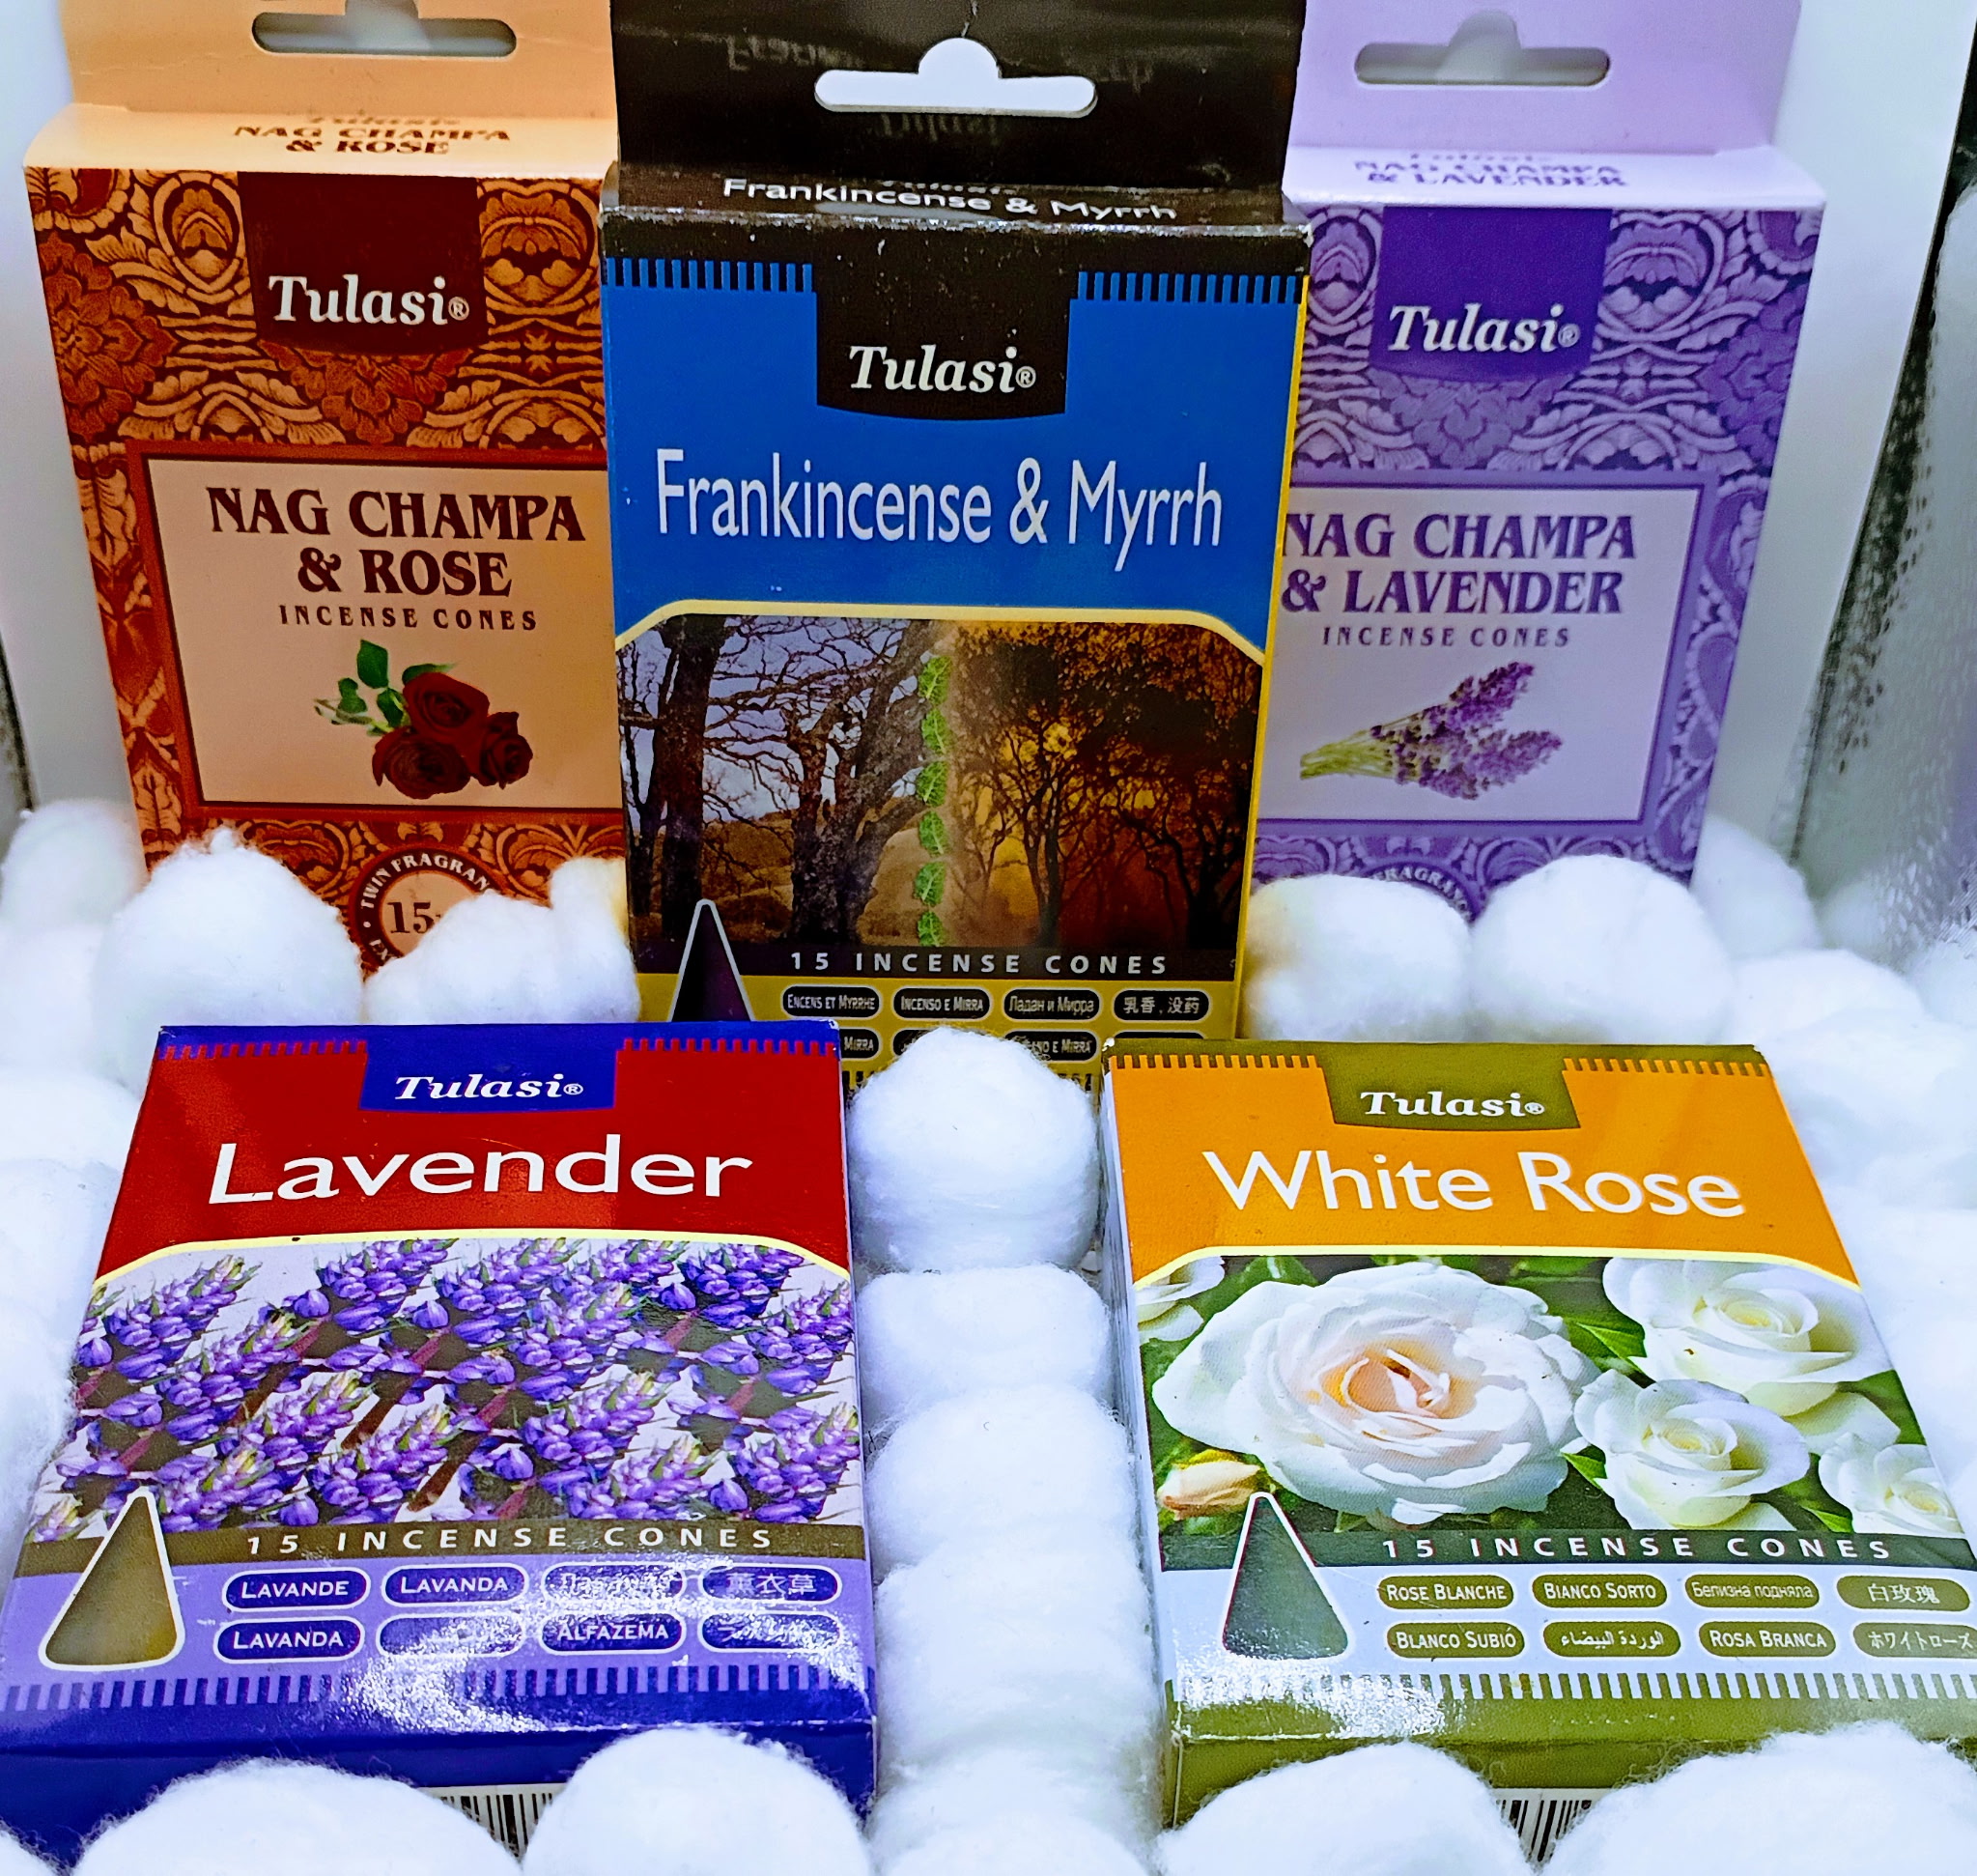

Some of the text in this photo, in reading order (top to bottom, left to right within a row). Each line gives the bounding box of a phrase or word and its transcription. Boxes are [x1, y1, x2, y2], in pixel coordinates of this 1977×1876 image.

[336, 141, 449, 155] ROSE
[722, 178, 992, 212] Frankincense
[1004, 198, 1039, 214] &
[1051, 200, 1178, 220] Myrrh
[206, 486, 587, 542] NAG CHAMPA
[657, 448, 1223, 573] Frankincense & Myrrh
[1282, 513, 1637, 559] NAG CHAMPA
[297, 547, 514, 598] & ROSE
[1281, 568, 1624, 614] & LAVENDER
[278, 604, 538, 632] INCENSE CONES
[1322, 627, 1570, 648] INCENSE CONES
[360, 852, 492, 910] TWIN FRAGRAN
[790, 952, 1167, 975] 15 INCENSE CONES
[208, 1133, 753, 1205] Lavender
[1201, 1150, 1746, 1218] White Rose
[247, 1526, 773, 1554] 15 INCENSE CONES
[1382, 1537, 1890, 1560] 15 INCENSE CONES
